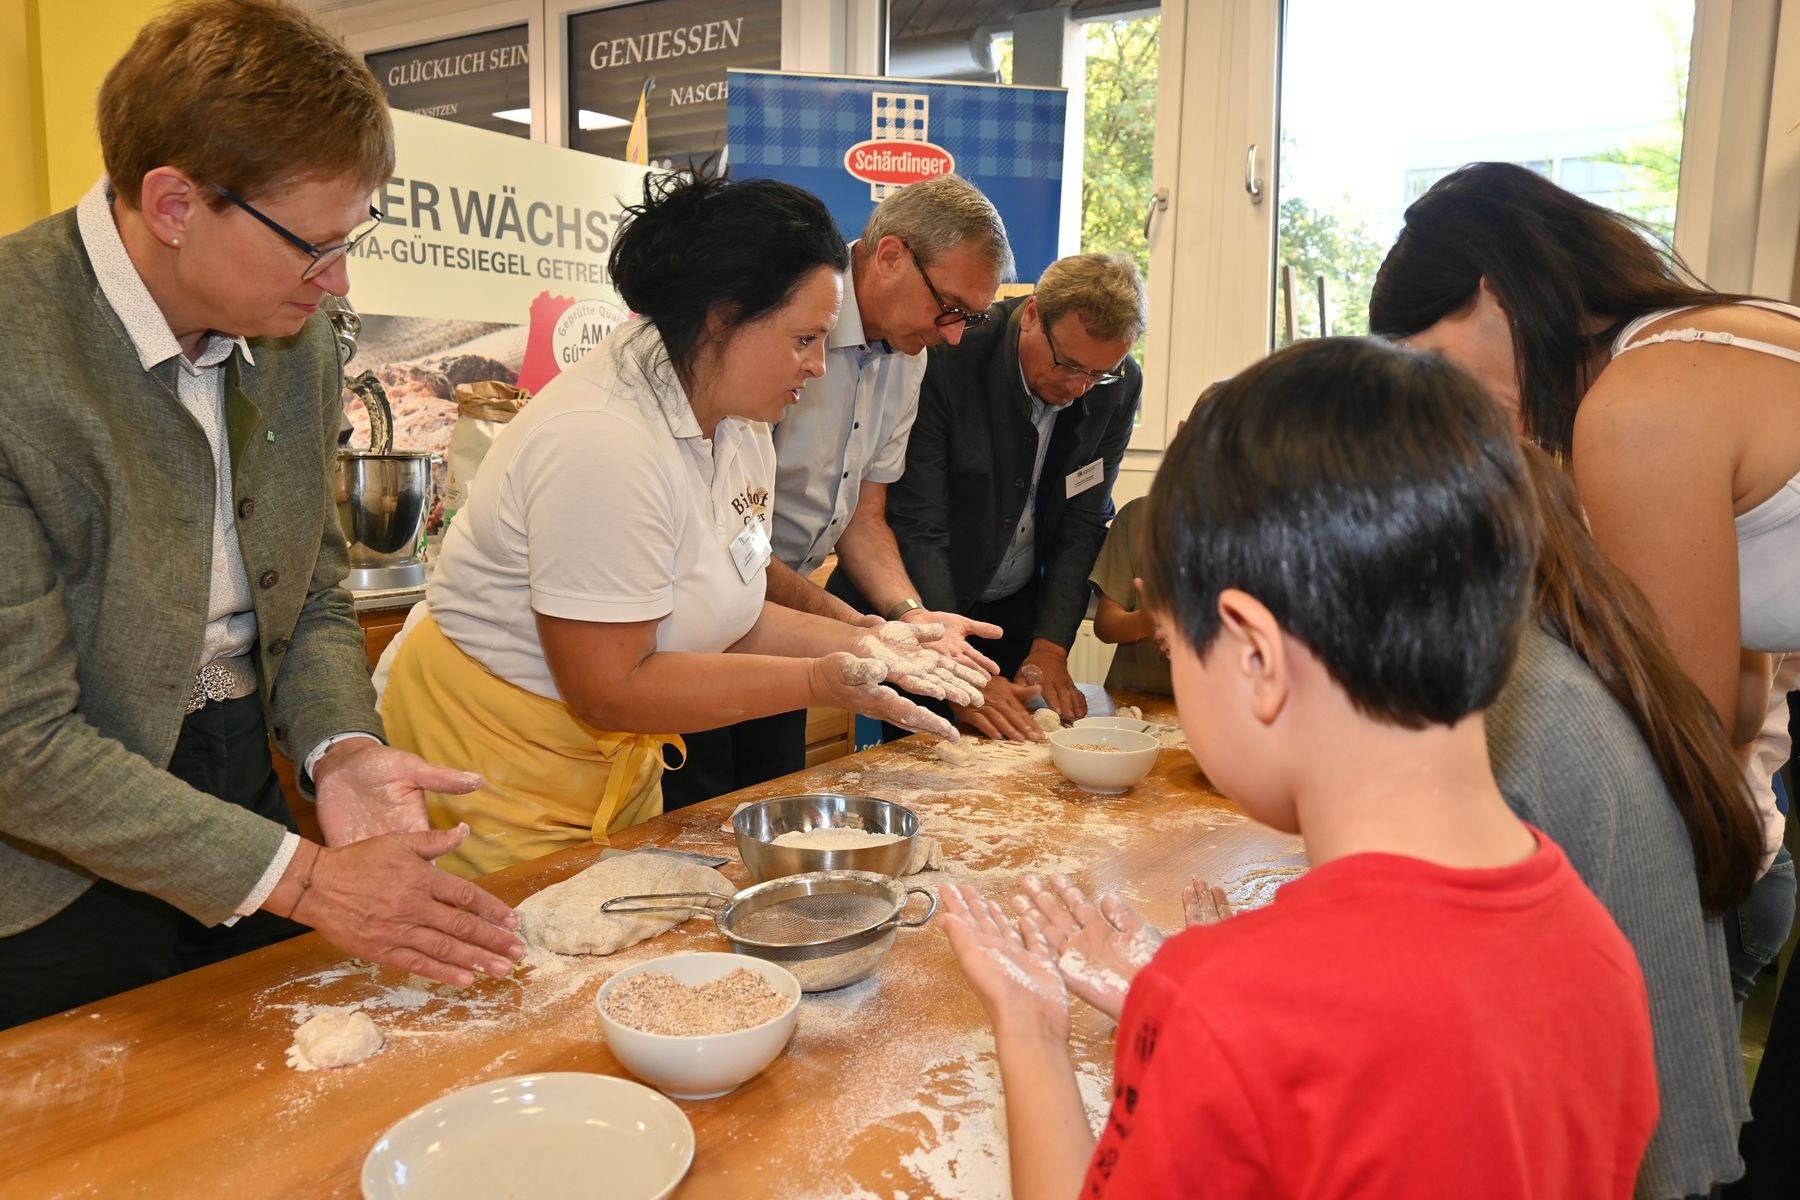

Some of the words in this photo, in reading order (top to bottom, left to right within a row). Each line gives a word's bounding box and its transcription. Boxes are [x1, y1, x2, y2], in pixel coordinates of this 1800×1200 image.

[590, 17, 744, 70] GENIESSEN
[388, 51, 485, 87] GLÜCKLICH
[489, 45, 529, 70] SEIN
[855, 149, 948, 176] Schärdinger
[378, 176, 441, 231] ER
[346, 234, 531, 276] MA-GÜTESIEGEL
[558, 305, 595, 337] Geprüfte
[563, 344, 592, 363] GÜT
